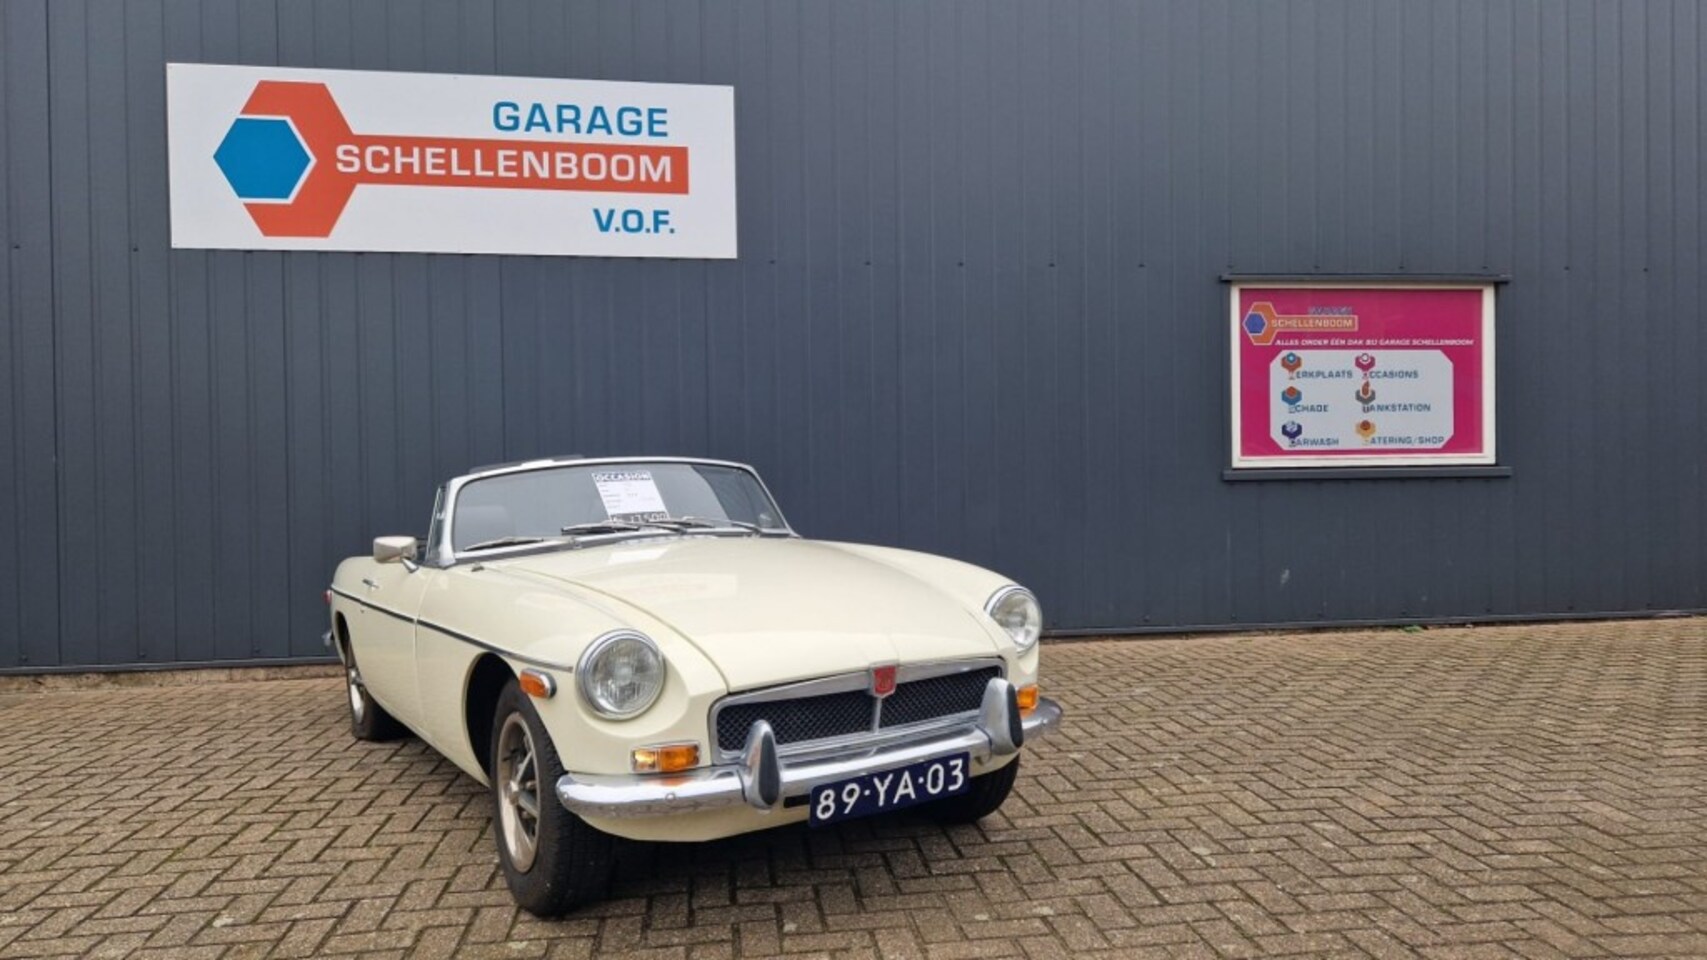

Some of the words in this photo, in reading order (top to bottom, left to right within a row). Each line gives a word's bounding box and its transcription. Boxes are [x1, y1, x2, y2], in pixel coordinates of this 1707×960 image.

[493, 101, 669, 138] GARAGE
[335, 143, 673, 183] SCHELLENBOOM
[593, 207, 676, 234] V.O.F.
[1272, 318, 1353, 328] SCHELLENBOOM
[1275, 338, 1299, 346] ALLES
